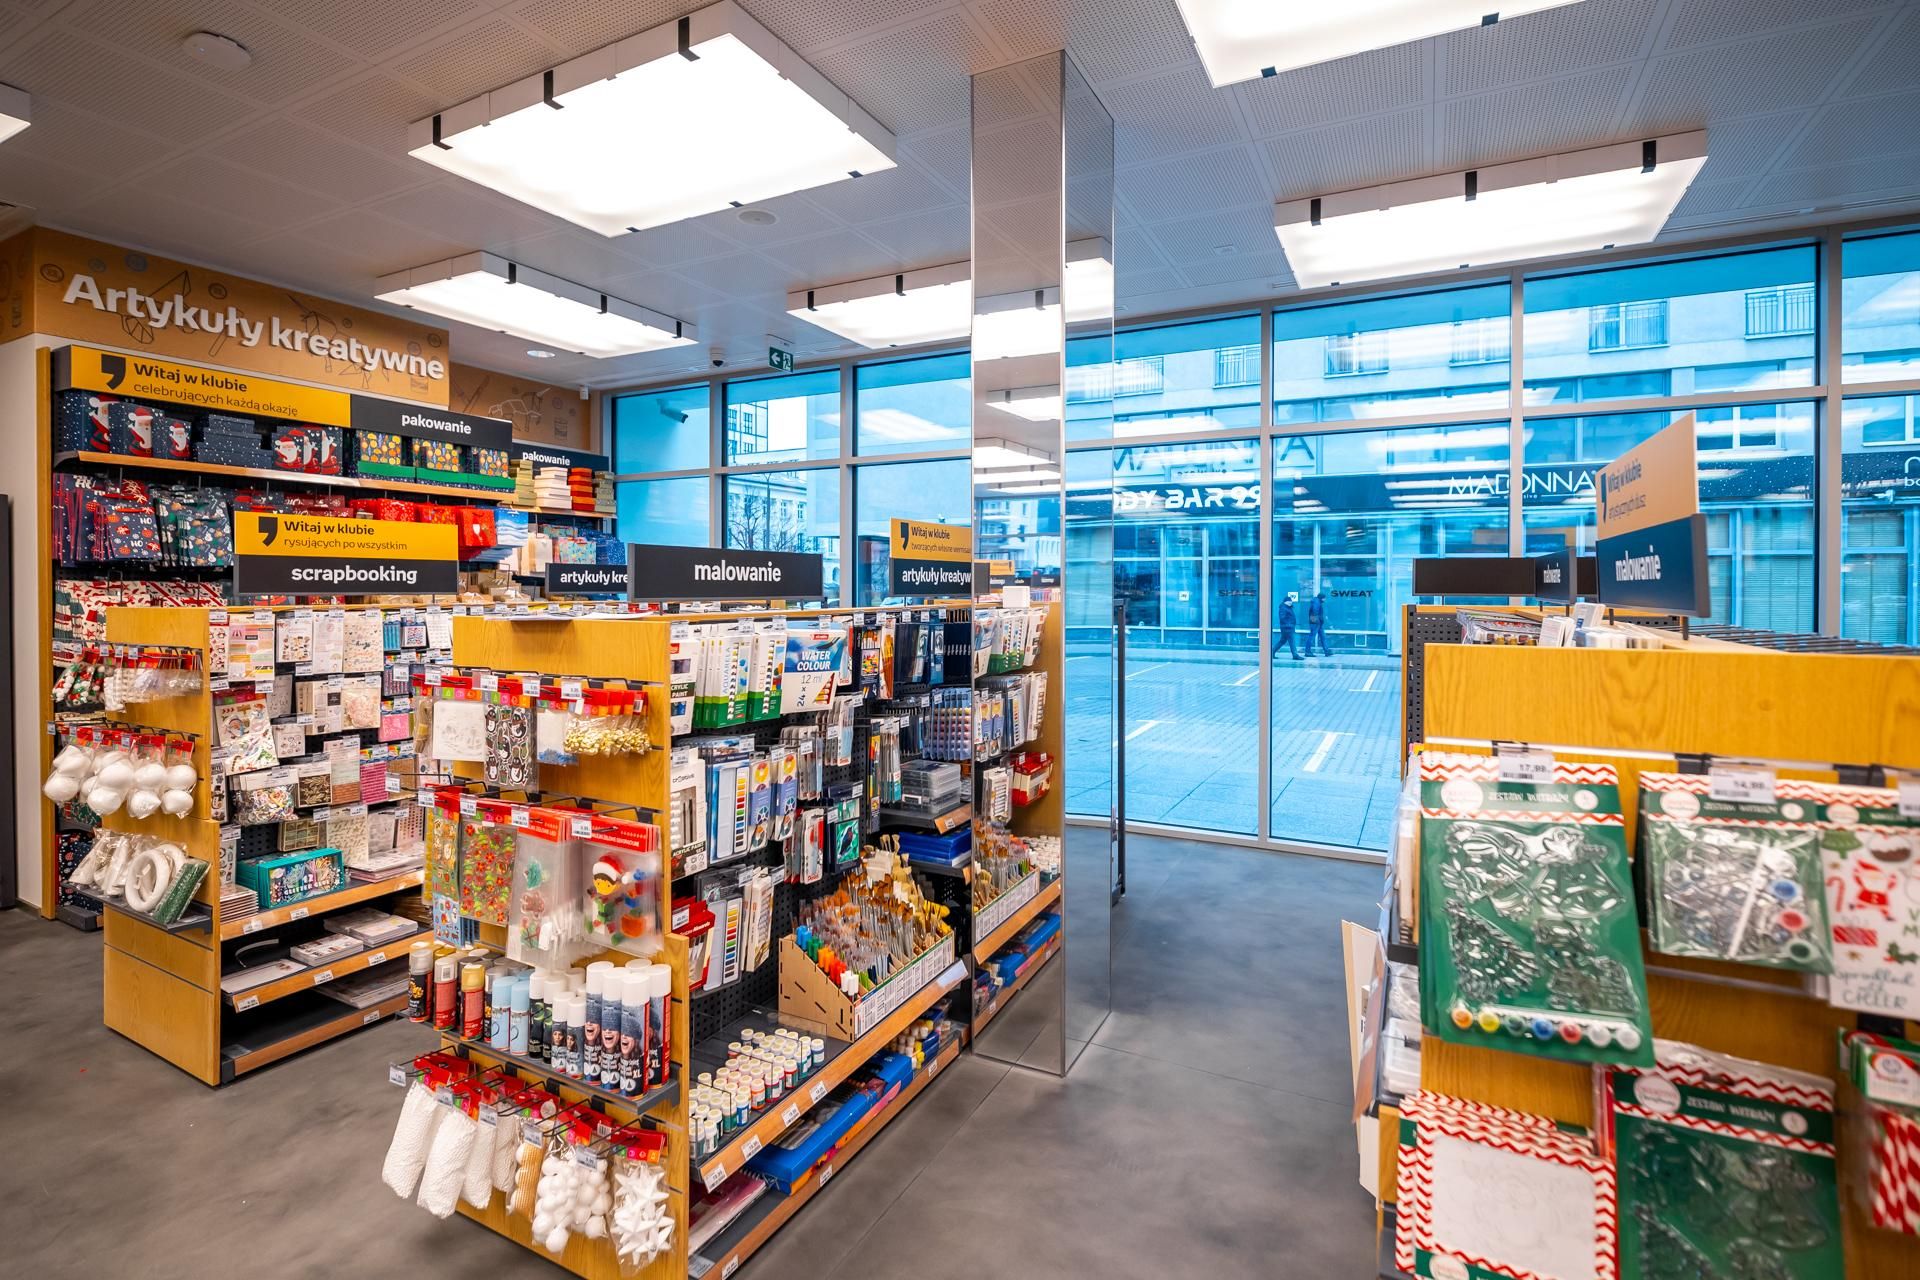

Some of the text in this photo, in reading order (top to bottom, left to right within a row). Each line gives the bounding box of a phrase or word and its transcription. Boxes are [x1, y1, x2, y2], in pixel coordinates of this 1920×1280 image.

[63, 274, 444, 379] Artykuły kreatywne
[134, 363, 247, 392] Witaj w klubie
[134, 383, 298, 417] celebrujących każdą okazję
[401, 414, 472, 434] pakowanie
[522, 451, 571, 466] pakowanie
[1164, 487, 1226, 509] BAR
[284, 520, 375, 535] Witaj w klubie
[911, 526, 927, 539] Witaj
[934, 529, 950, 540] klubie
[284, 537, 407, 550] rysujących po wszystkim
[694, 560, 781, 582] malowanie
[1615, 545, 1661, 582] malowanie
[291, 564, 418, 584] scrapbooking
[560, 570, 611, 586] artykuły
[902, 566, 939, 586] artykuły
[940, 568, 972, 586] kreatyw
[1331, 589, 1374, 598] SWEAT
[797, 661, 830, 671] COLOUR
[802, 651, 830, 661] WATER
